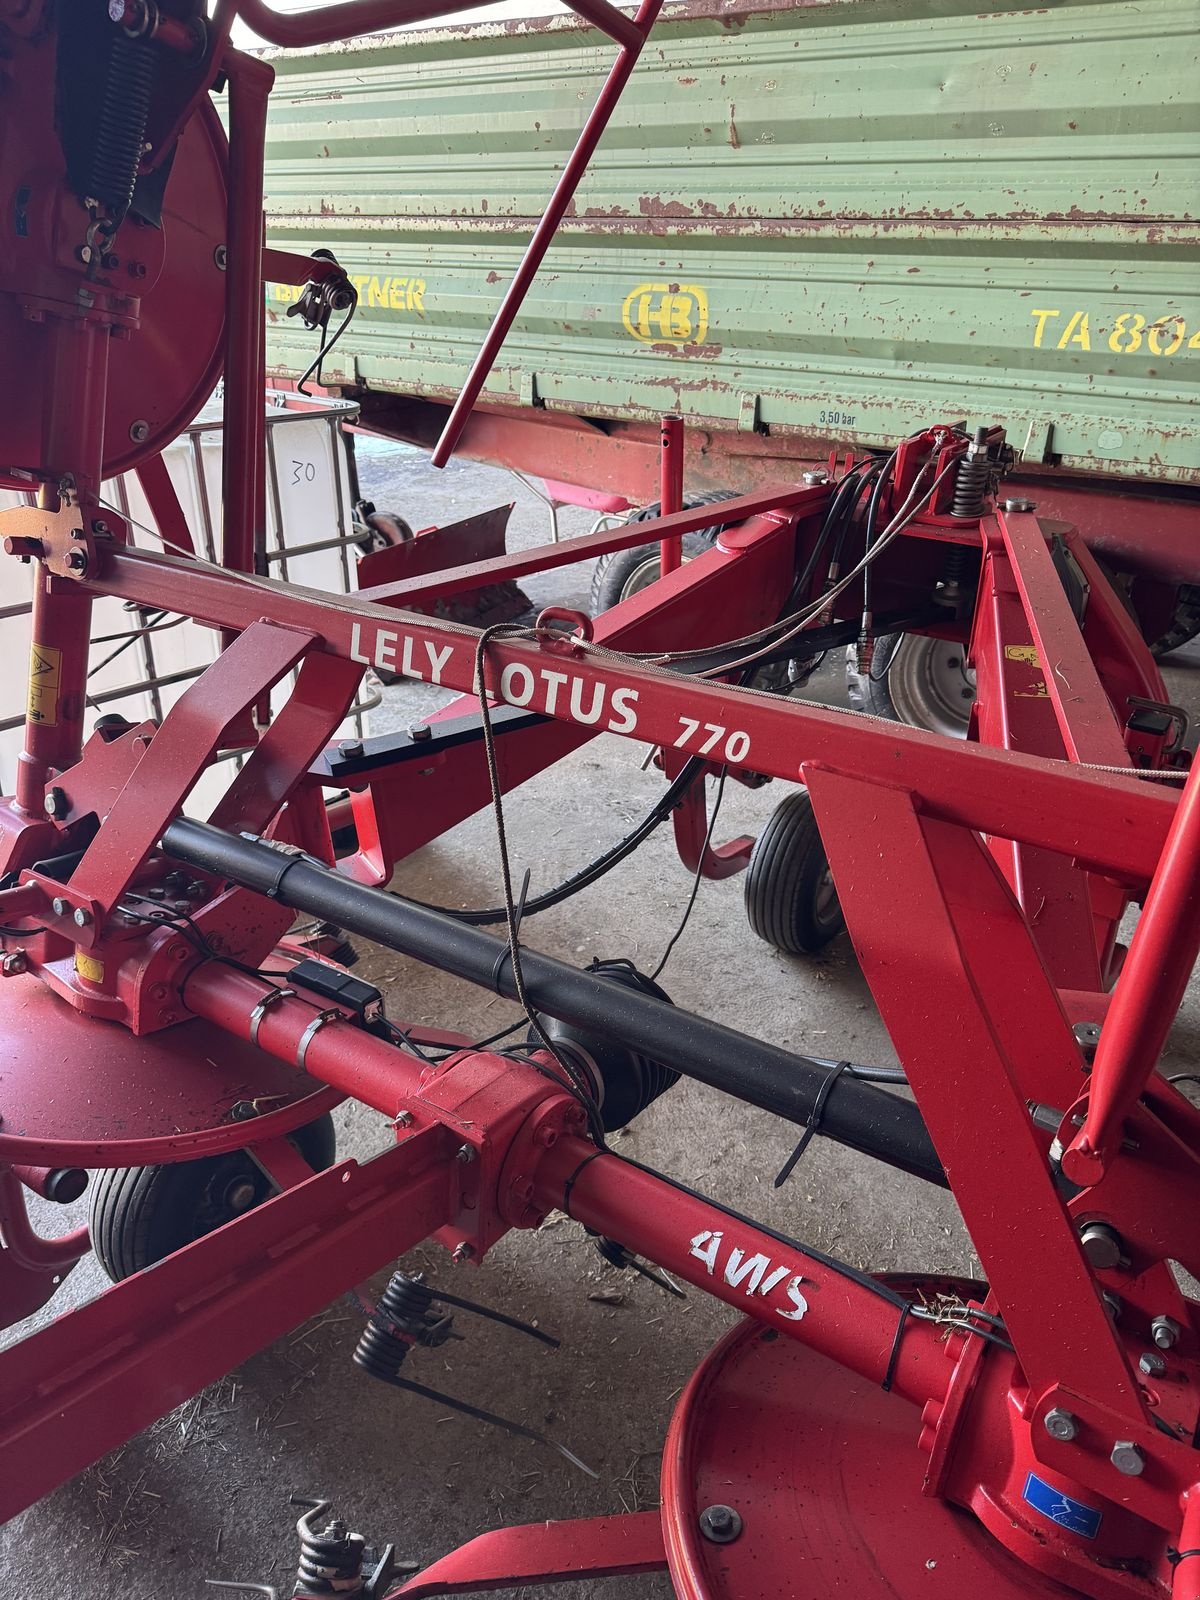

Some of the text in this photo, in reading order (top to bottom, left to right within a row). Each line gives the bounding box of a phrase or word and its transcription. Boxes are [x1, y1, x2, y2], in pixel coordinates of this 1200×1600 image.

[1031, 309, 1091, 351] TA
[842, 413, 856, 425] bar
[292, 460, 315, 485] 30
[350, 622, 454, 685] LELY
[673, 716, 751, 763] 770
